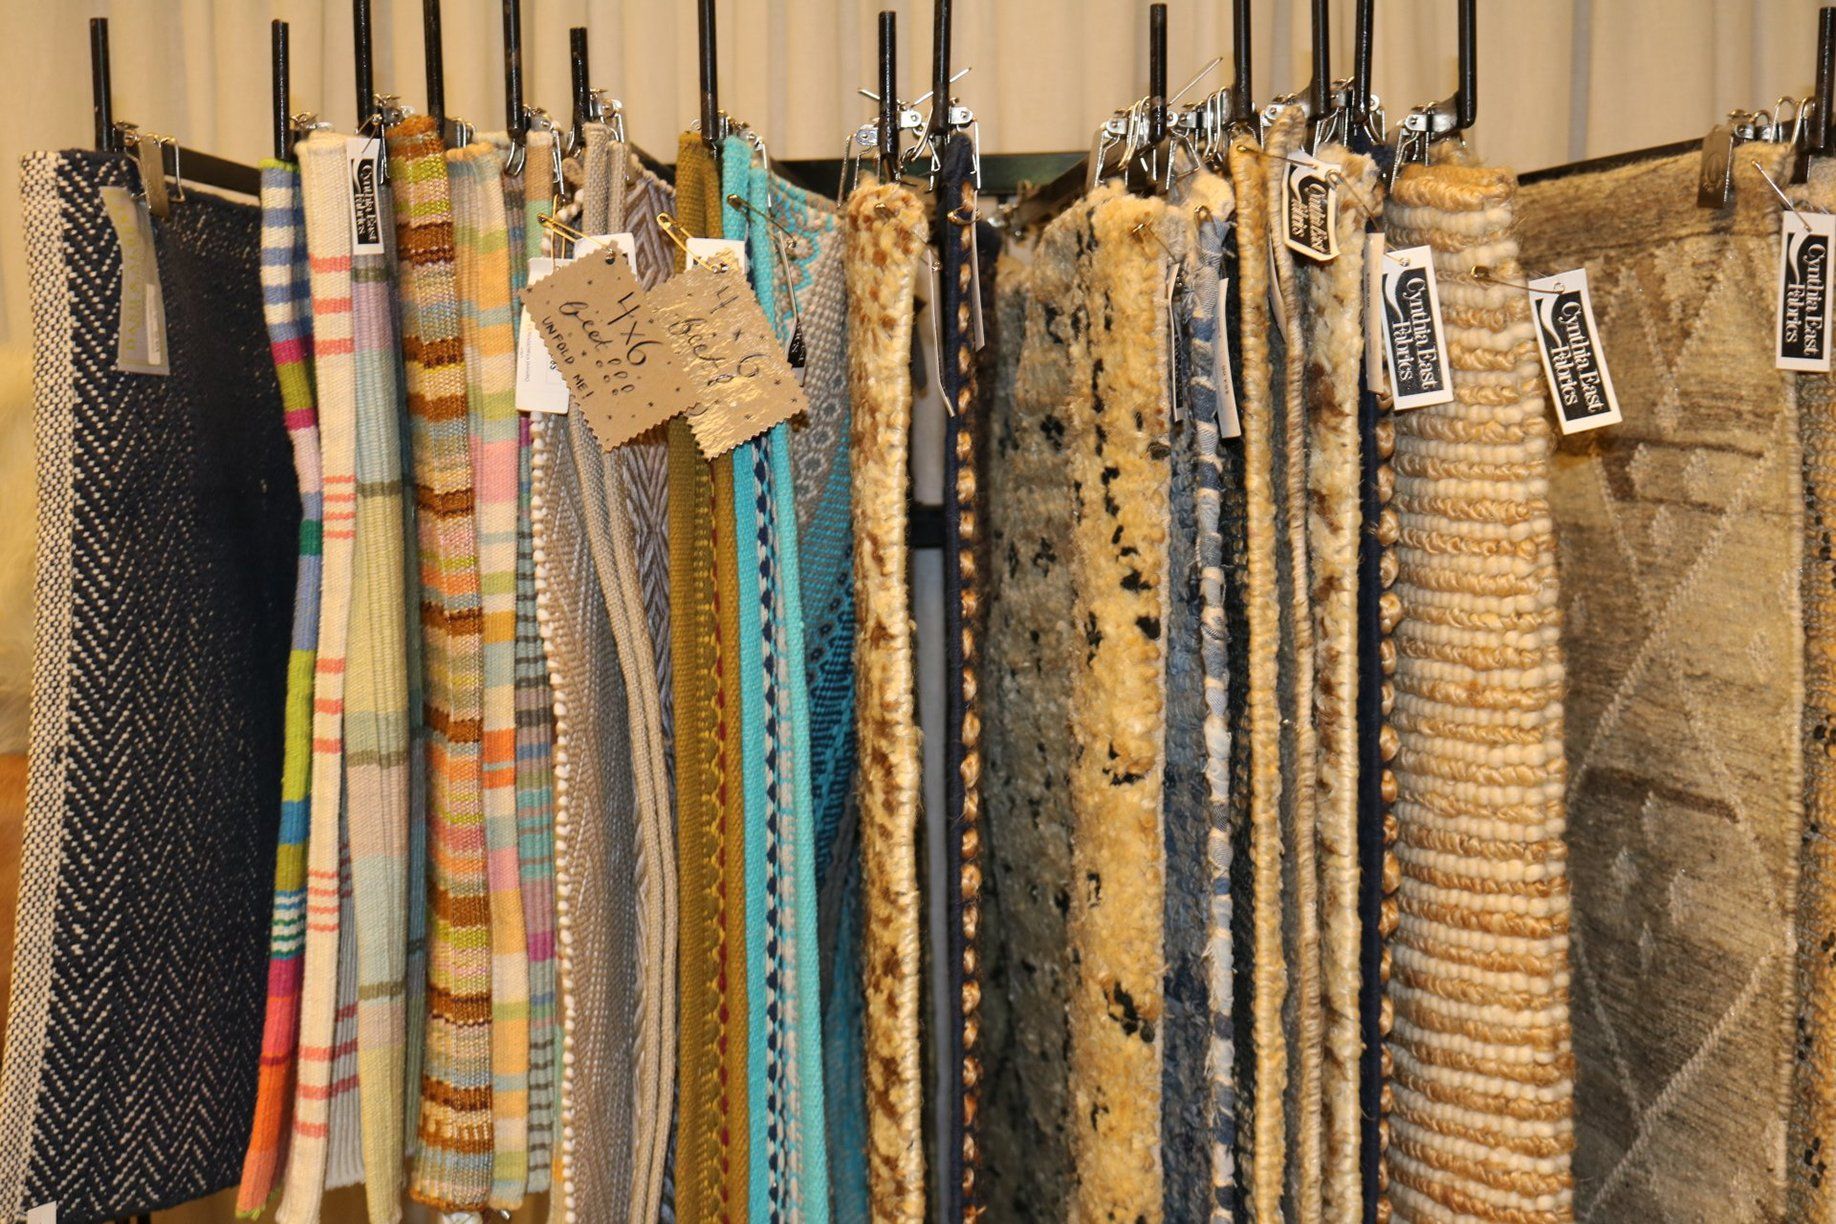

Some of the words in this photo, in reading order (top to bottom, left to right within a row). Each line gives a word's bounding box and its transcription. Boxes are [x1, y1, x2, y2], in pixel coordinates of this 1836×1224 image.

[1803, 243, 1827, 313] Cynthia
[1403, 276, 1431, 347] Cynthia
[1418, 344, 1439, 392] East
[1784, 282, 1807, 344] Fabrics
[1801, 314, 1824, 357] East
[542, 315, 576, 365] UNFOLD
[572, 373, 595, 400] ME!
[1392, 319, 1414, 382] Fabrics
[1550, 346, 1579, 407] Fabrics
[1557, 300, 1592, 371] Cynthia
[1577, 366, 1606, 412] East
